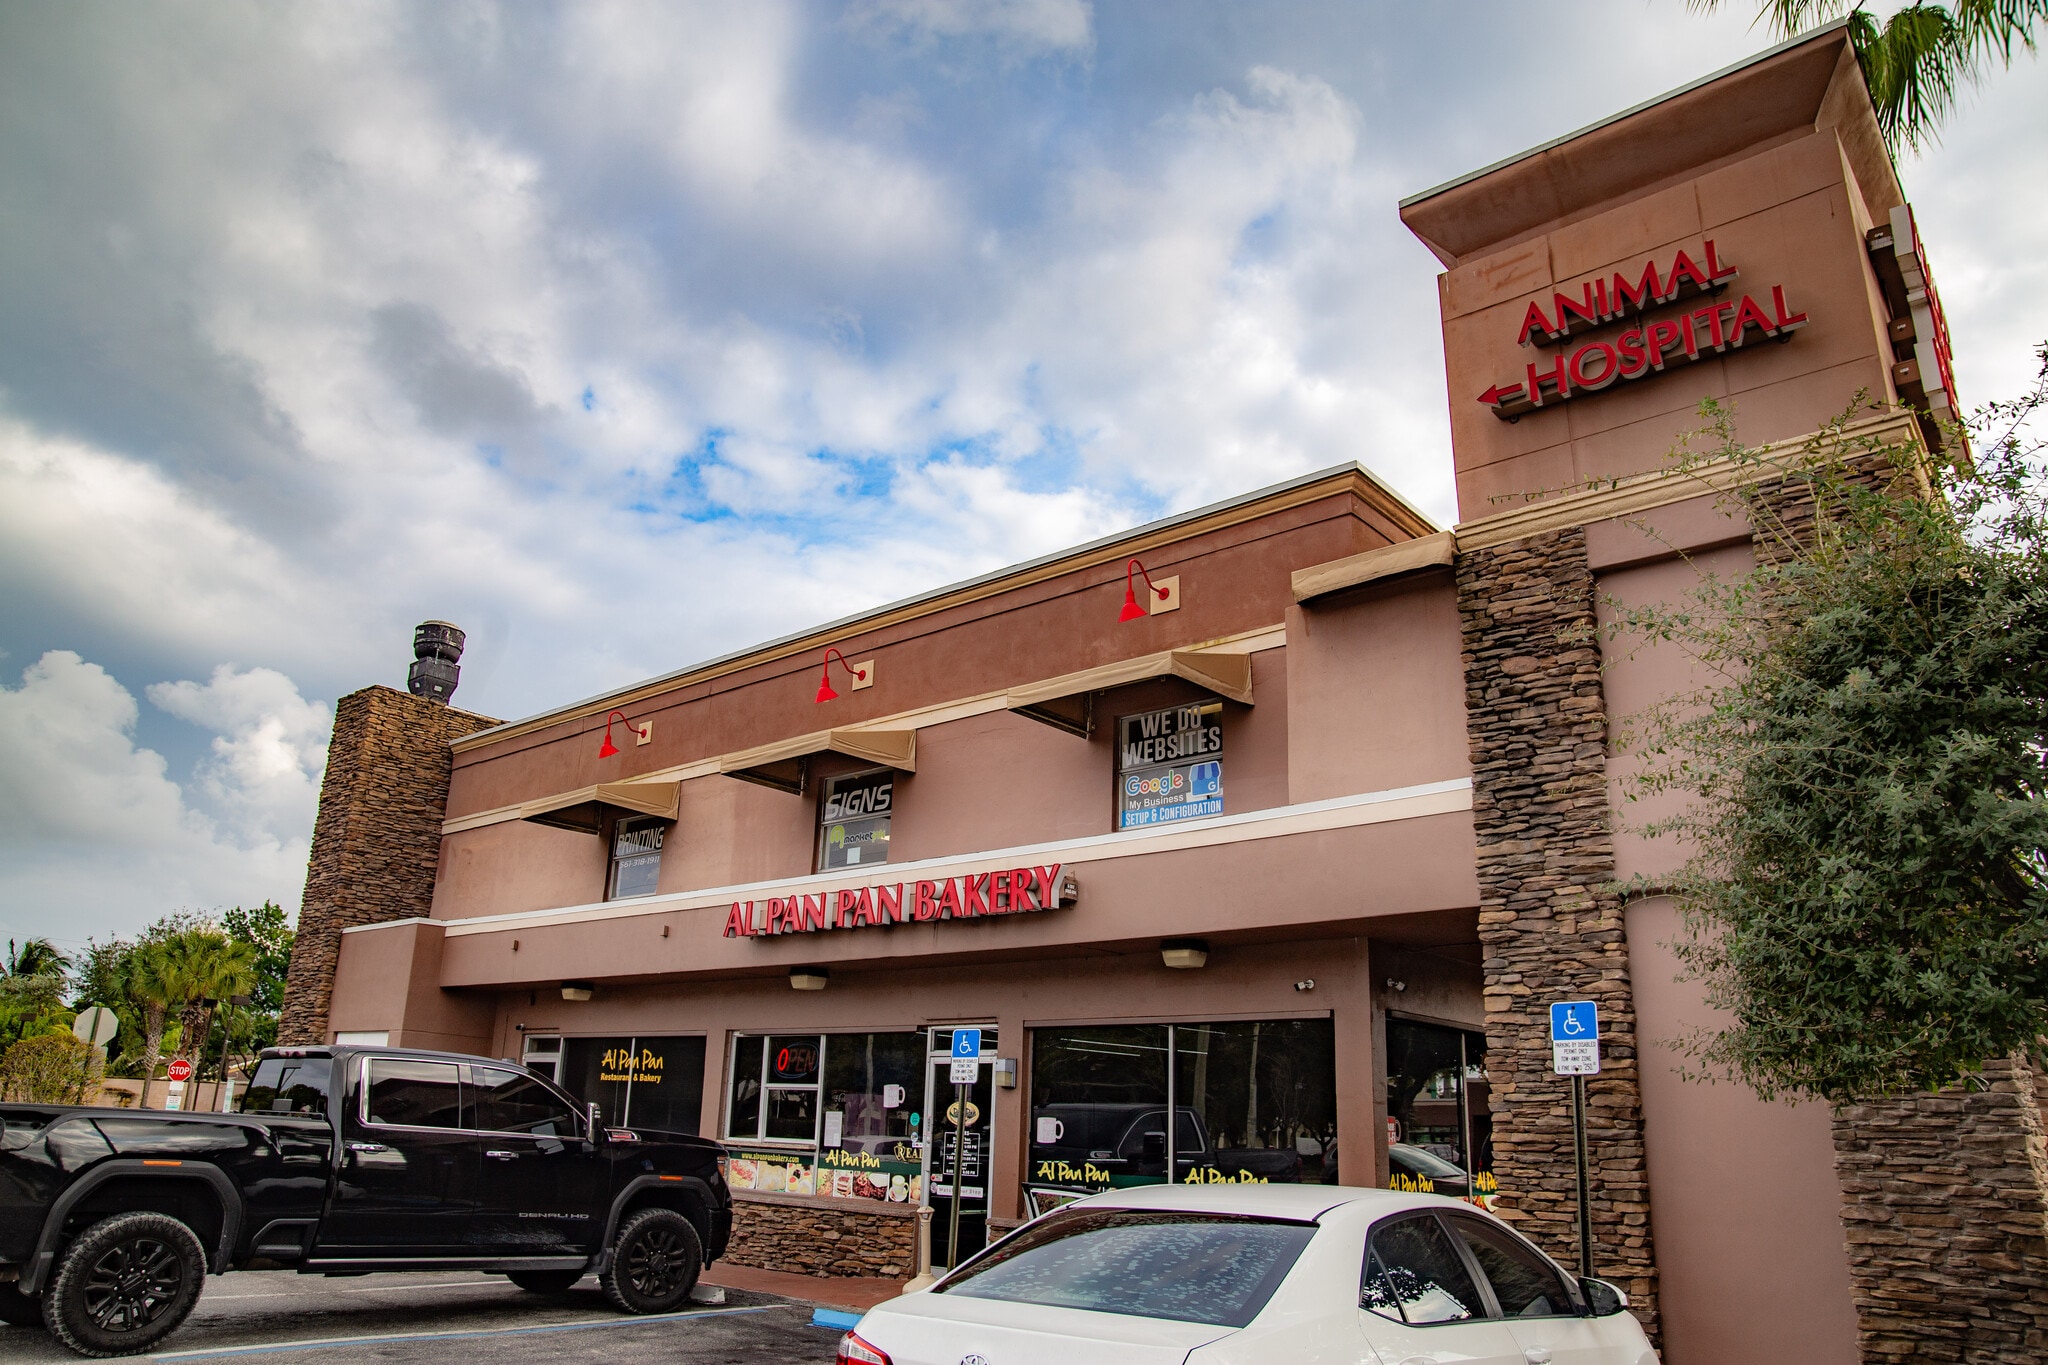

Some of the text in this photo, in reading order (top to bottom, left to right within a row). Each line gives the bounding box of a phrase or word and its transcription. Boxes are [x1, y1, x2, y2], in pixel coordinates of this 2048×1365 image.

[1518, 239, 1739, 347] ANIMAL
[1527, 285, 1808, 406] HOSPITAL
[1140, 705, 1202, 738] WE DO
[1123, 726, 1221, 766] WEBSITES
[1125, 770, 1183, 795] Google
[825, 784, 893, 820] SIGNS
[1125, 799, 1221, 826] SETUP & CONFIGURATION
[1129, 794, 1184, 810] My Business
[616, 826, 665, 854] PRINTING
[723, 863, 1066, 938] AL PAN PAN BAKERY
[170, 1066, 190, 1075] STOP
[601, 1048, 663, 1071] Al Pan Pan
[777, 1048, 816, 1072] OPEN
[600, 1073, 661, 1084] Restauran & Bakery
[825, 1149, 880, 1168] Al Pan Pan
[1037, 1162, 1110, 1183] Al Pan Pan
[1184, 1167, 1204, 1184] Al
[1389, 1172, 1434, 1192] Al Pan Pan
[1476, 1171, 1498, 1191] Al Pa
